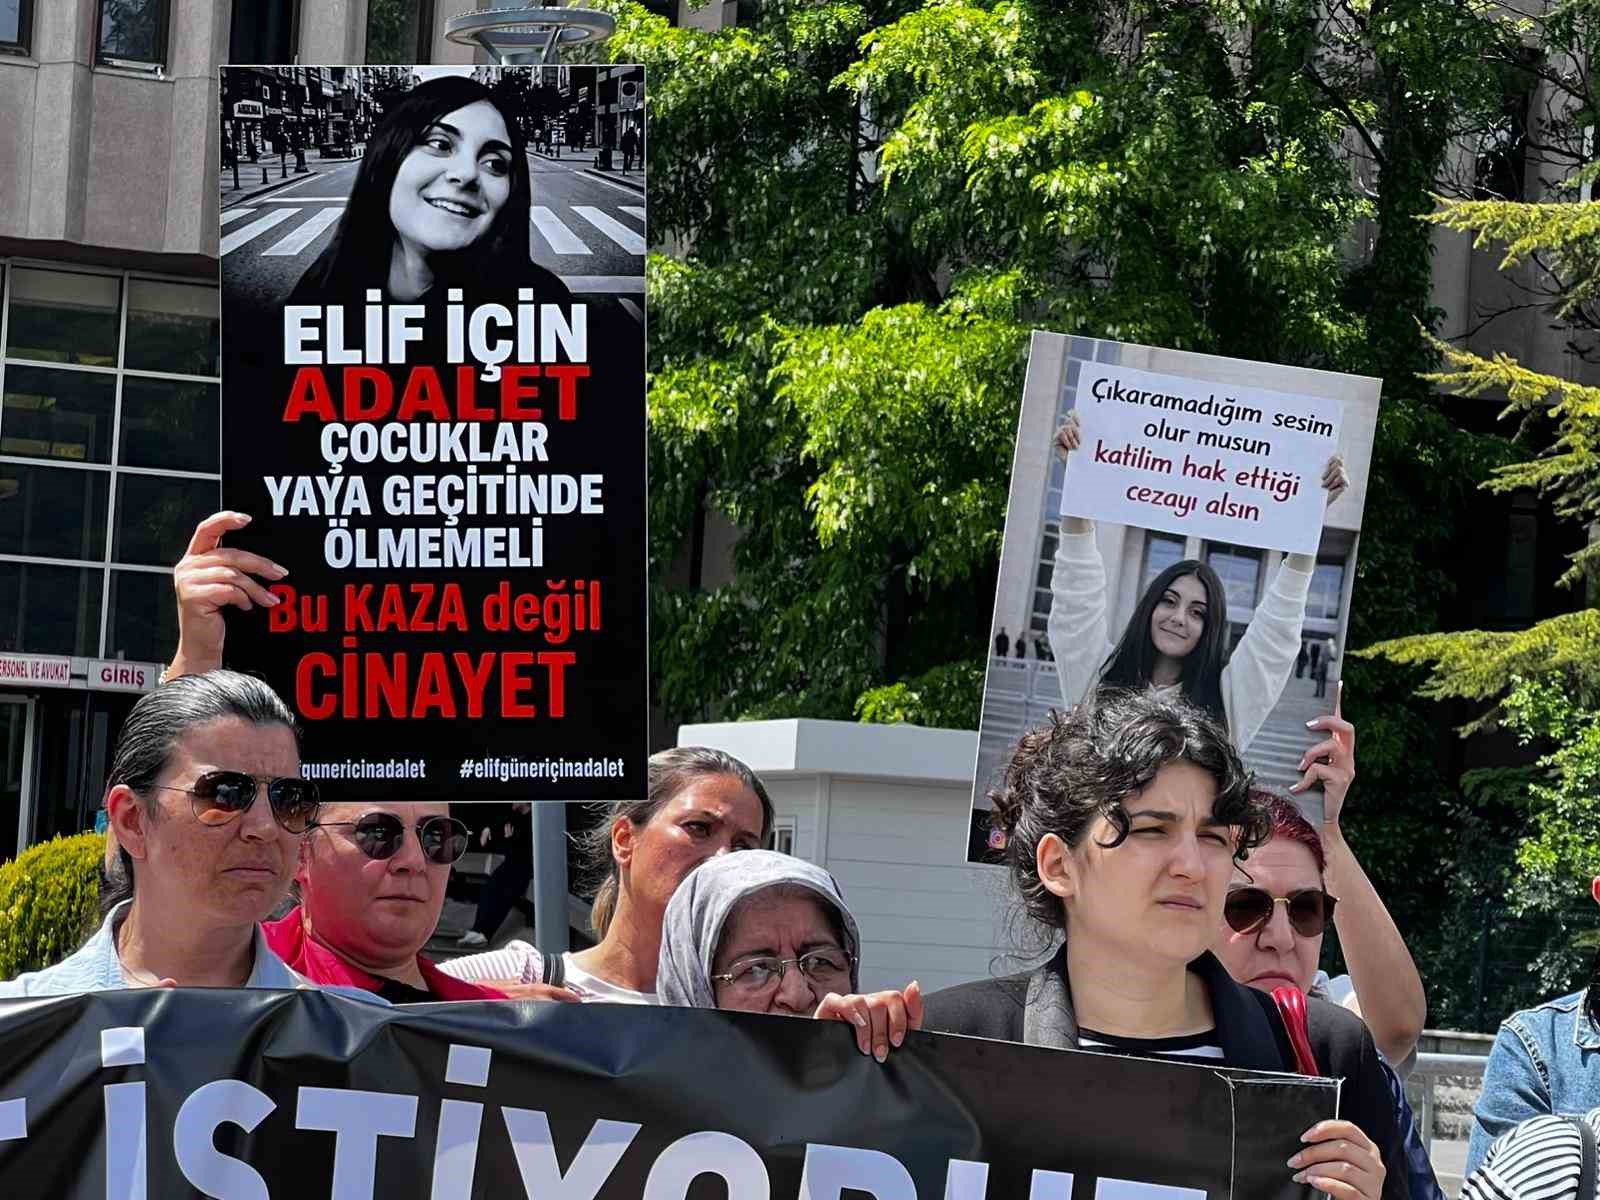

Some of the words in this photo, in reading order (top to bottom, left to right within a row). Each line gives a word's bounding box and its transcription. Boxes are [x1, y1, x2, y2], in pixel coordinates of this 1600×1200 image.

[284, 288, 426, 365] ELİF
[446, 287, 588, 382] İÇİN
[282, 364, 592, 423] ADALET
[1091, 378, 1262, 426] Çıkaramadığım
[1271, 412, 1333, 437] sesim
[320, 421, 549, 475] ÇOCUKLAR
[1143, 418, 1190, 442] olur
[1196, 431, 1271, 456] musun
[263, 475, 372, 516] YAYA
[382, 465, 604, 526] GEÇİTİNDE
[1094, 439, 1172, 474] katilim
[1182, 454, 1227, 482] hak
[1235, 466, 1301, 502] ettiği
[1126, 485, 1198, 518] cezayı
[1205, 491, 1260, 521] alsın
[323, 517, 544, 569] ÖLMEMELİ
[269, 584, 328, 633] Bu
[344, 583, 468, 633] KAZA
[482, 579, 602, 645] değil
[0, 660, 28, 678] RSONEL
[30, 661, 40, 679] VE
[41, 662, 68, 681] AVUKAT
[101, 664, 145, 688] GİRİŞ
[295, 635, 577, 721] CİNAYET
[299, 758, 426, 783] gunericinadalet
[459, 757, 625, 783] #elifgüneriçinadalet
